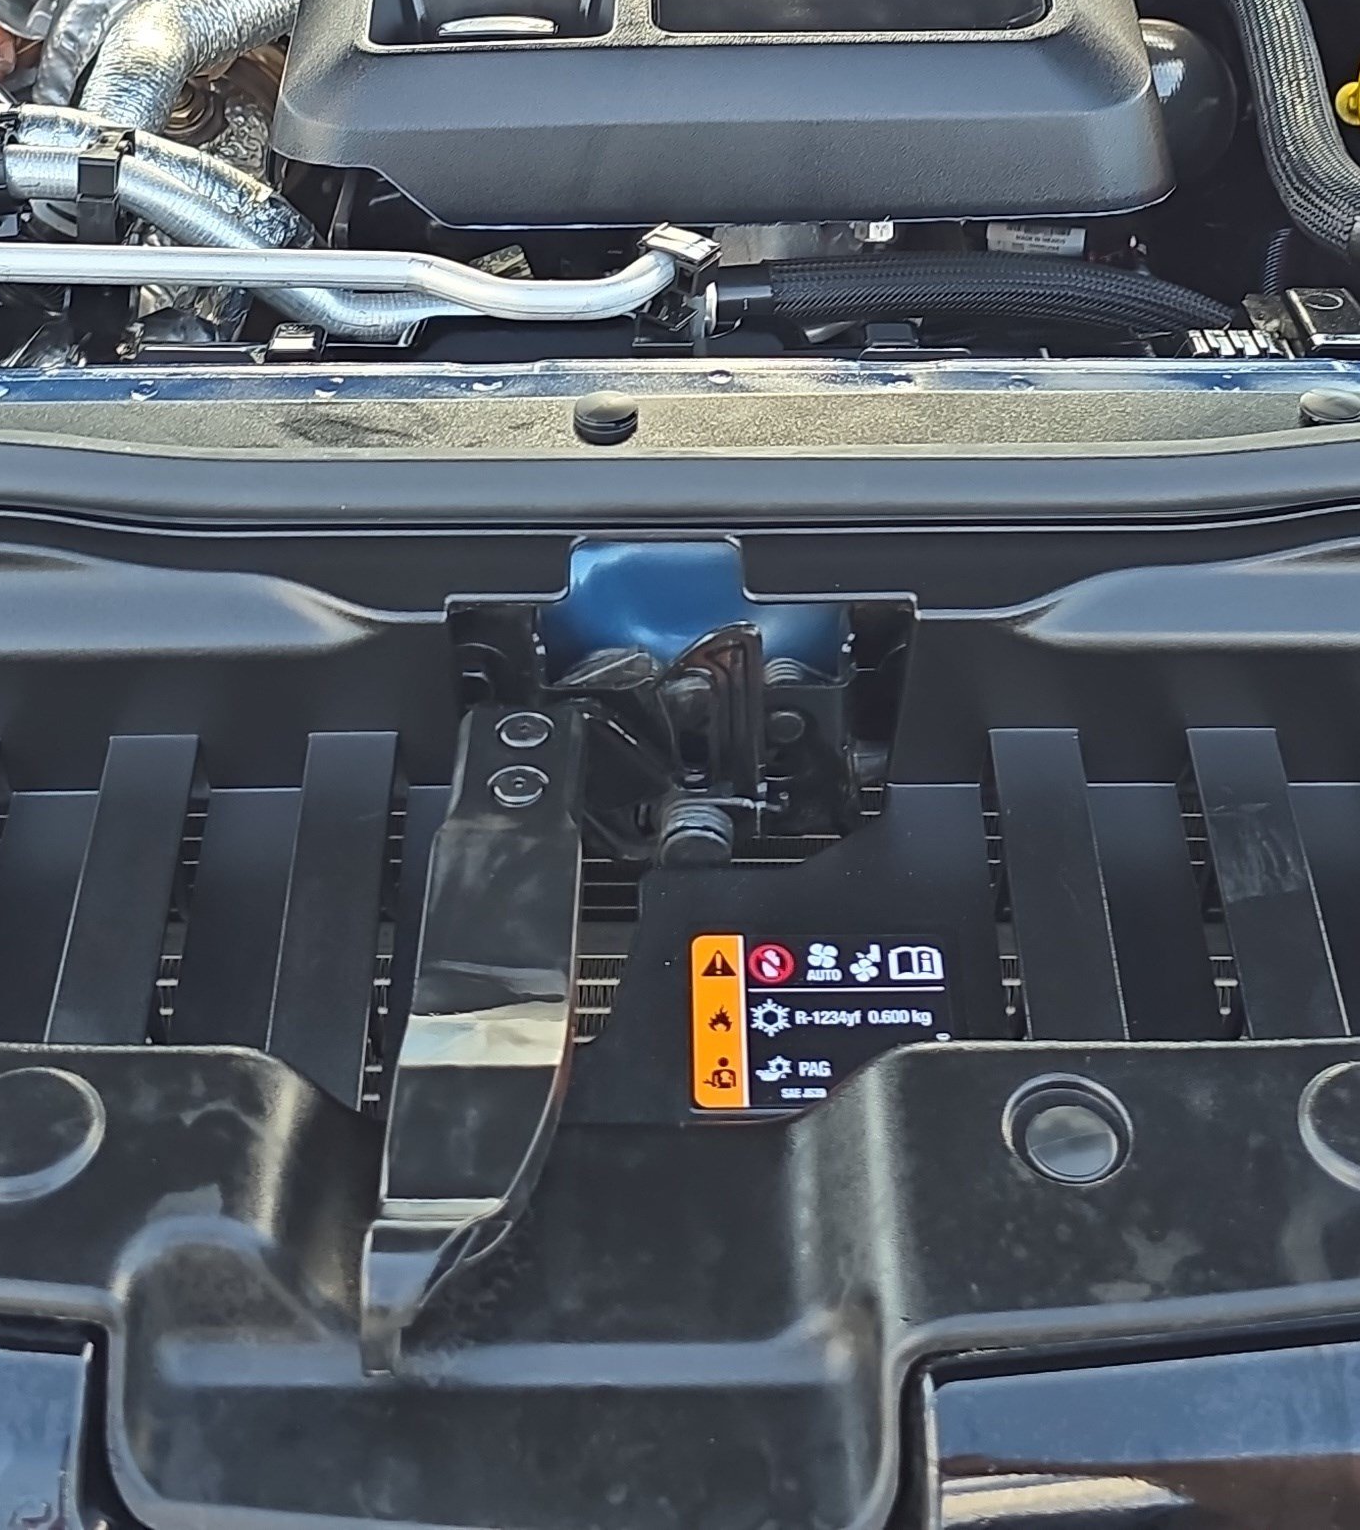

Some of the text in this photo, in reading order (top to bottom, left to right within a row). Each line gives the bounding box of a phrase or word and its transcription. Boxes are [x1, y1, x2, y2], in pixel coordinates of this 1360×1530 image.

[806, 968, 842, 982] AUTO
[794, 1010, 933, 1027] R-1234yf 0.600 kg
[798, 1060, 832, 1078] PAG
